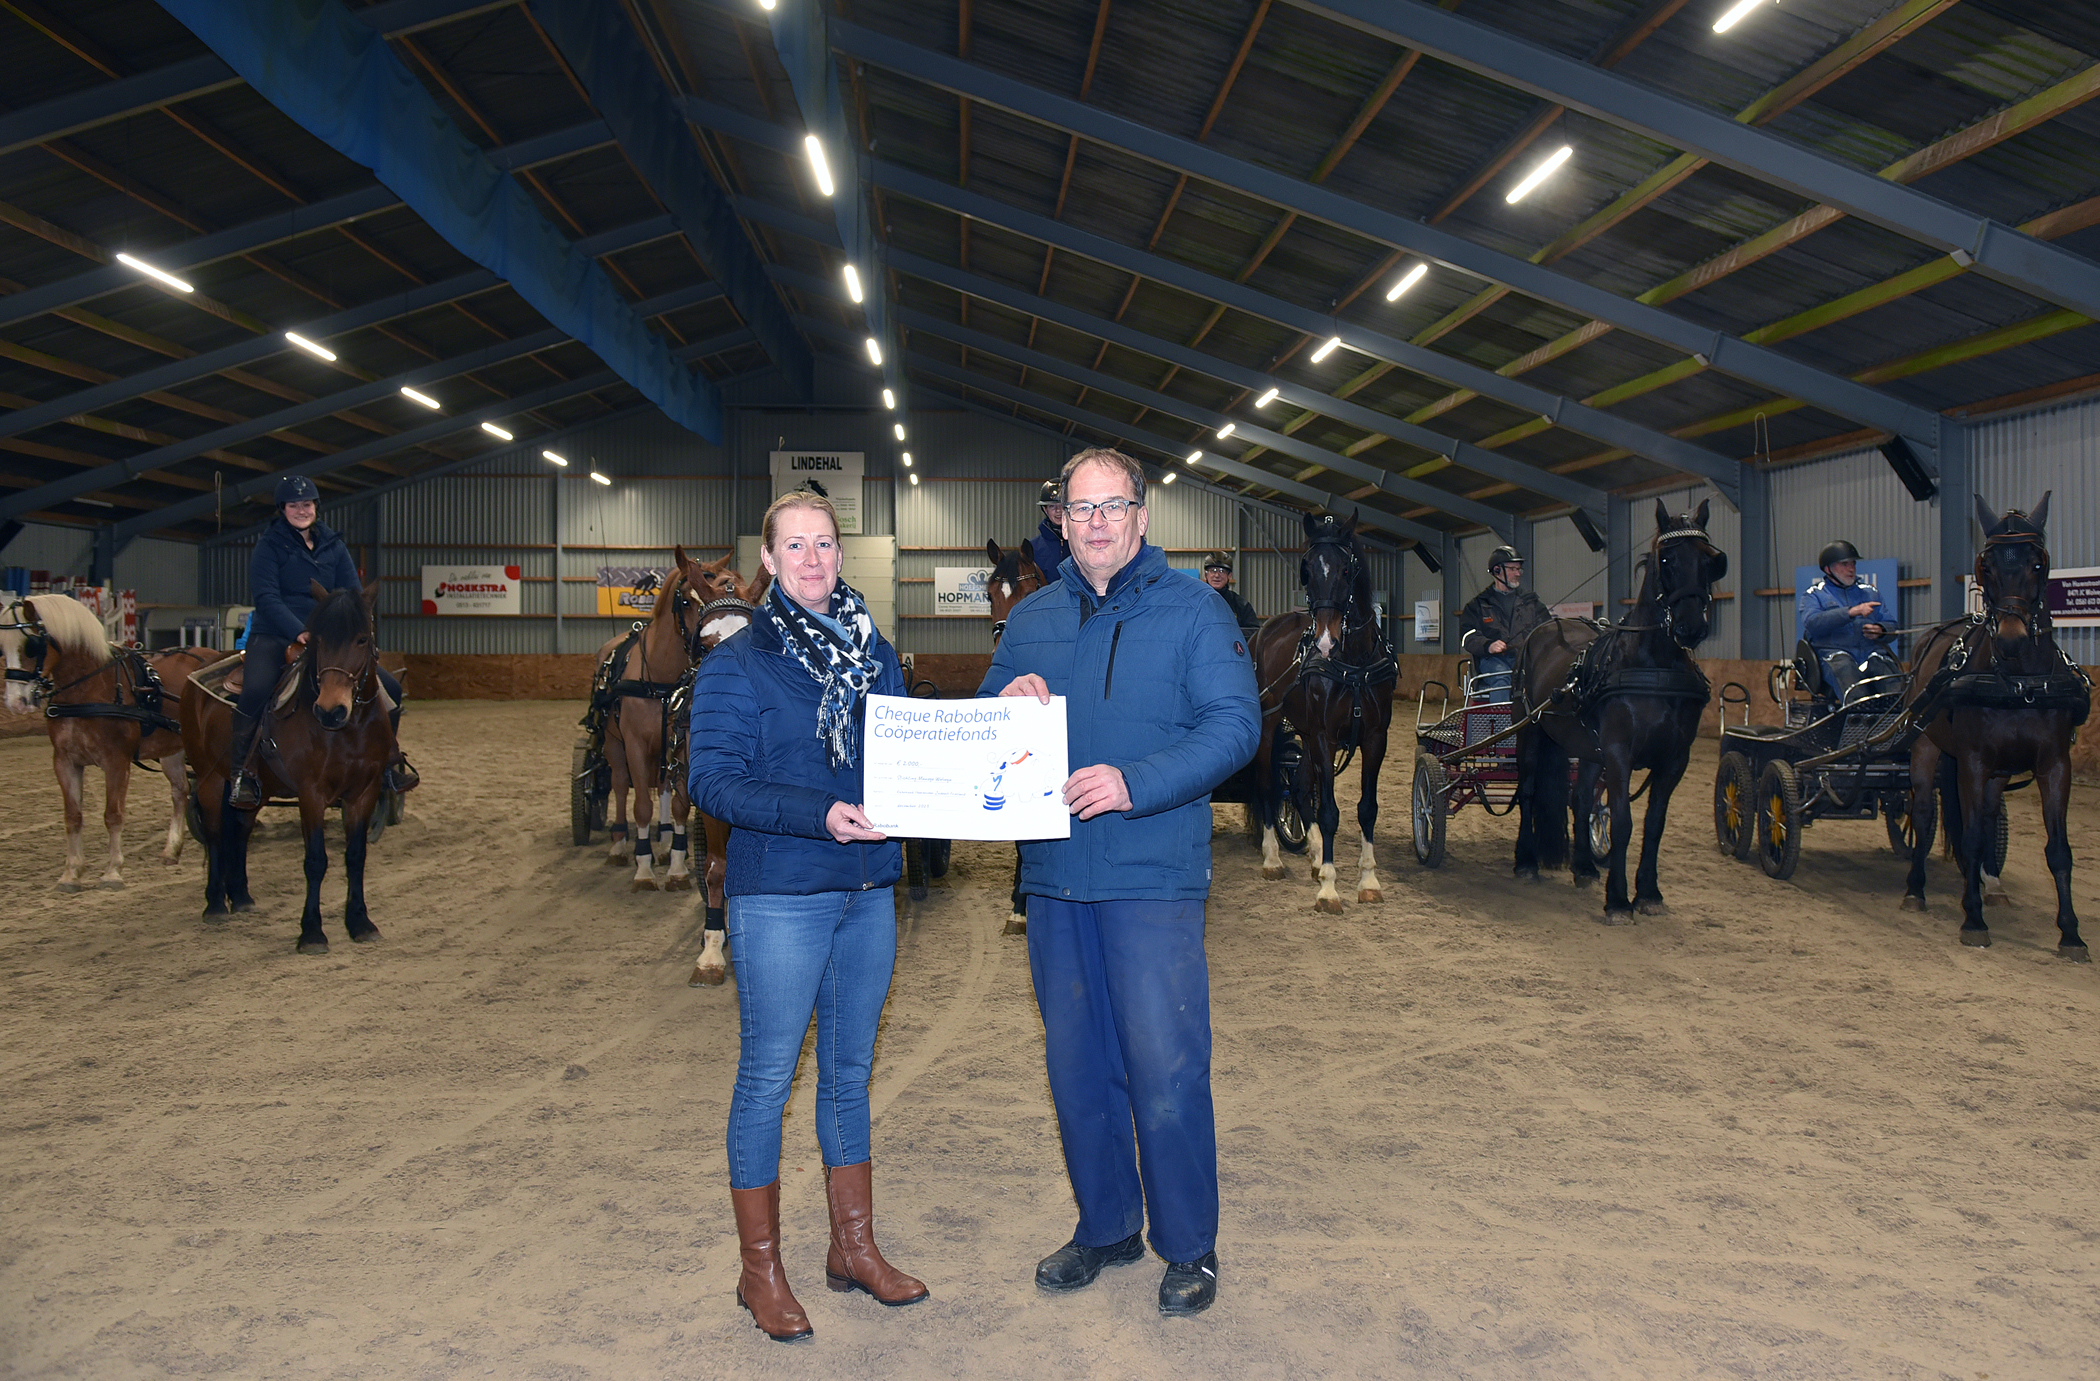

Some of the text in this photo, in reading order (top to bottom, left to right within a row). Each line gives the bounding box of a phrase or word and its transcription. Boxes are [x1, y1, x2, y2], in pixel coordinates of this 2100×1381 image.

[792, 456, 842, 470] LINDEHAL
[447, 584, 507, 592] HOEKSTRA
[905, 656, 912, 667] A
[874, 705, 1011, 724] Cheque Rabobank
[874, 723, 998, 742] Coöperatiefonds
